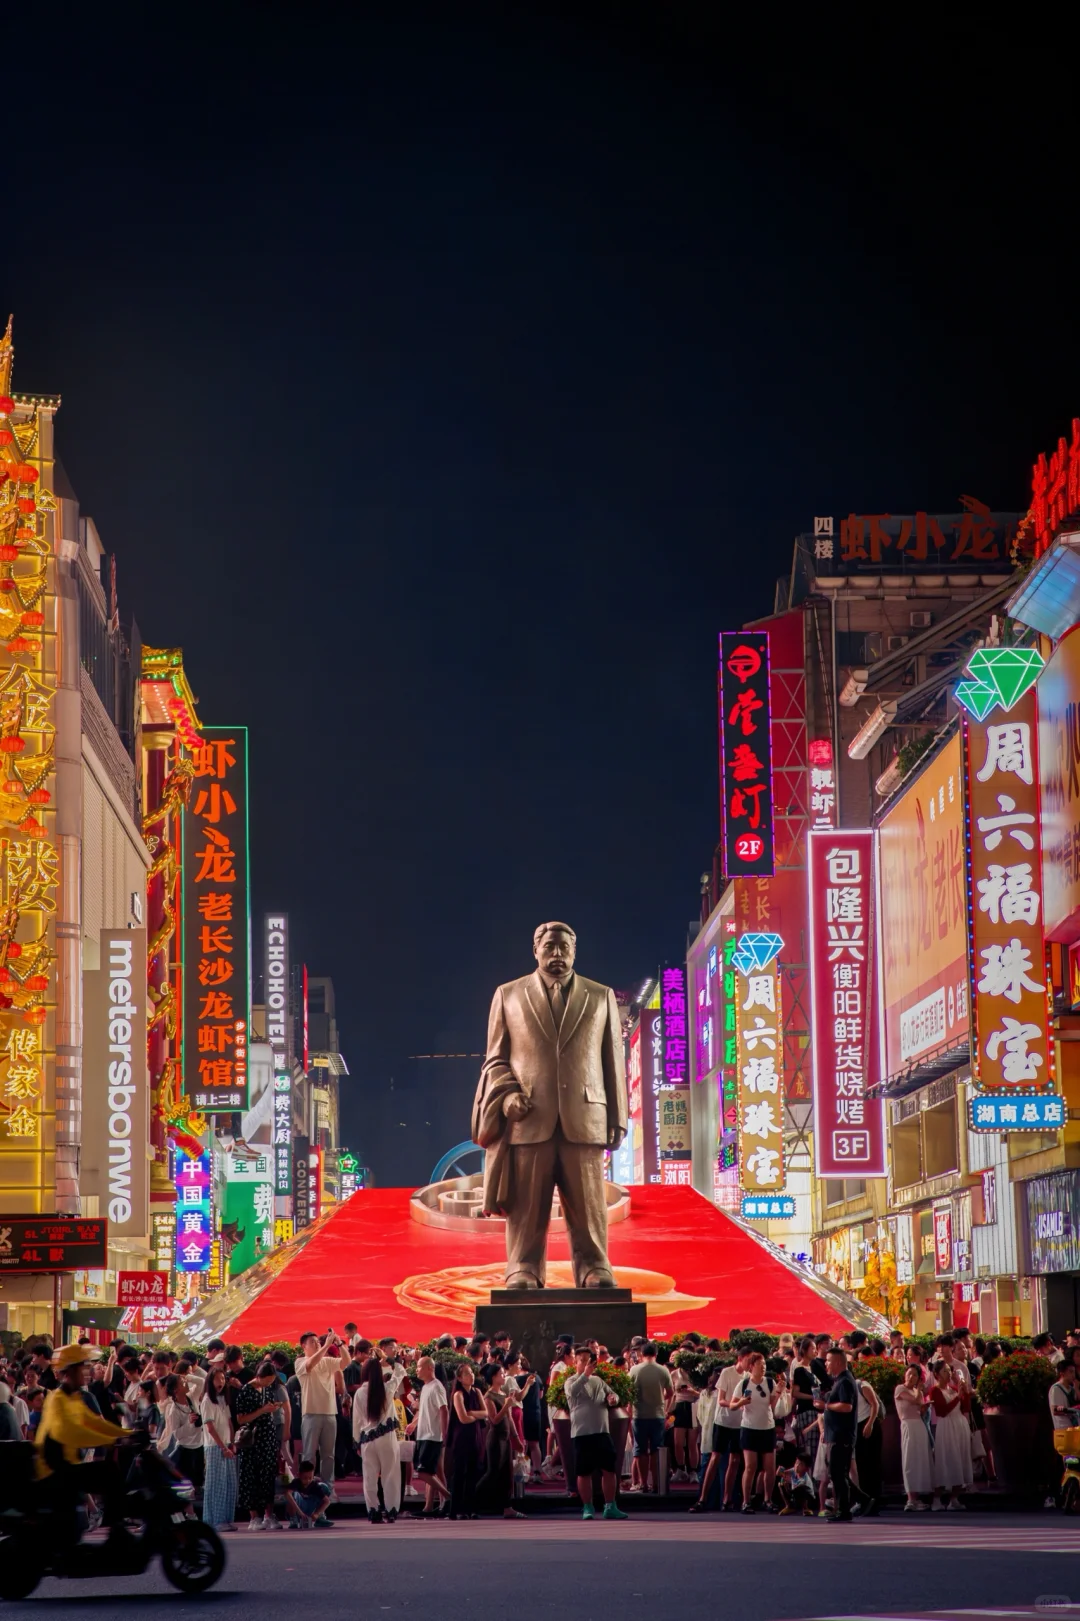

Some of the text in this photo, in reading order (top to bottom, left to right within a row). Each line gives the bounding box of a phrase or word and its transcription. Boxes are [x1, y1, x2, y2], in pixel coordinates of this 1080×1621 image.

[814, 516, 834, 559] 四楼
[840, 495, 1000, 562] 虾小龙
[738, 840, 761, 855] 2F
[193, 739, 237, 1086] 虾小龙 老长沙龙虾馆
[976, 722, 1046, 1083] 周六福珠宝
[825, 848, 864, 1124] 包隆兴 衡阳鲜货烧烤
[663, 968, 686, 1078] 美栖酒店 5F
[235, 1021, 246, 1086] 步行街二店
[742, 975, 782, 1185] 周六福珠宝
[4, 1028, 39, 1137] 传家金
[108, 940, 137, 1224] metersbonwe
[195, 1093, 240, 1106] 请上二楼
[275, 1095, 291, 1143] 费大厨
[976, 1102, 1061, 1123] 湖南总店
[838, 1137, 865, 1156] 3F
[182, 1160, 204, 1263] 中国黄金
[744, 1202, 794, 1214] 湖南总店
[22, 1249, 42, 1261] 4L
[121, 1274, 164, 1294] 虾小龙
[143, 1299, 184, 1320] 虾小龙
